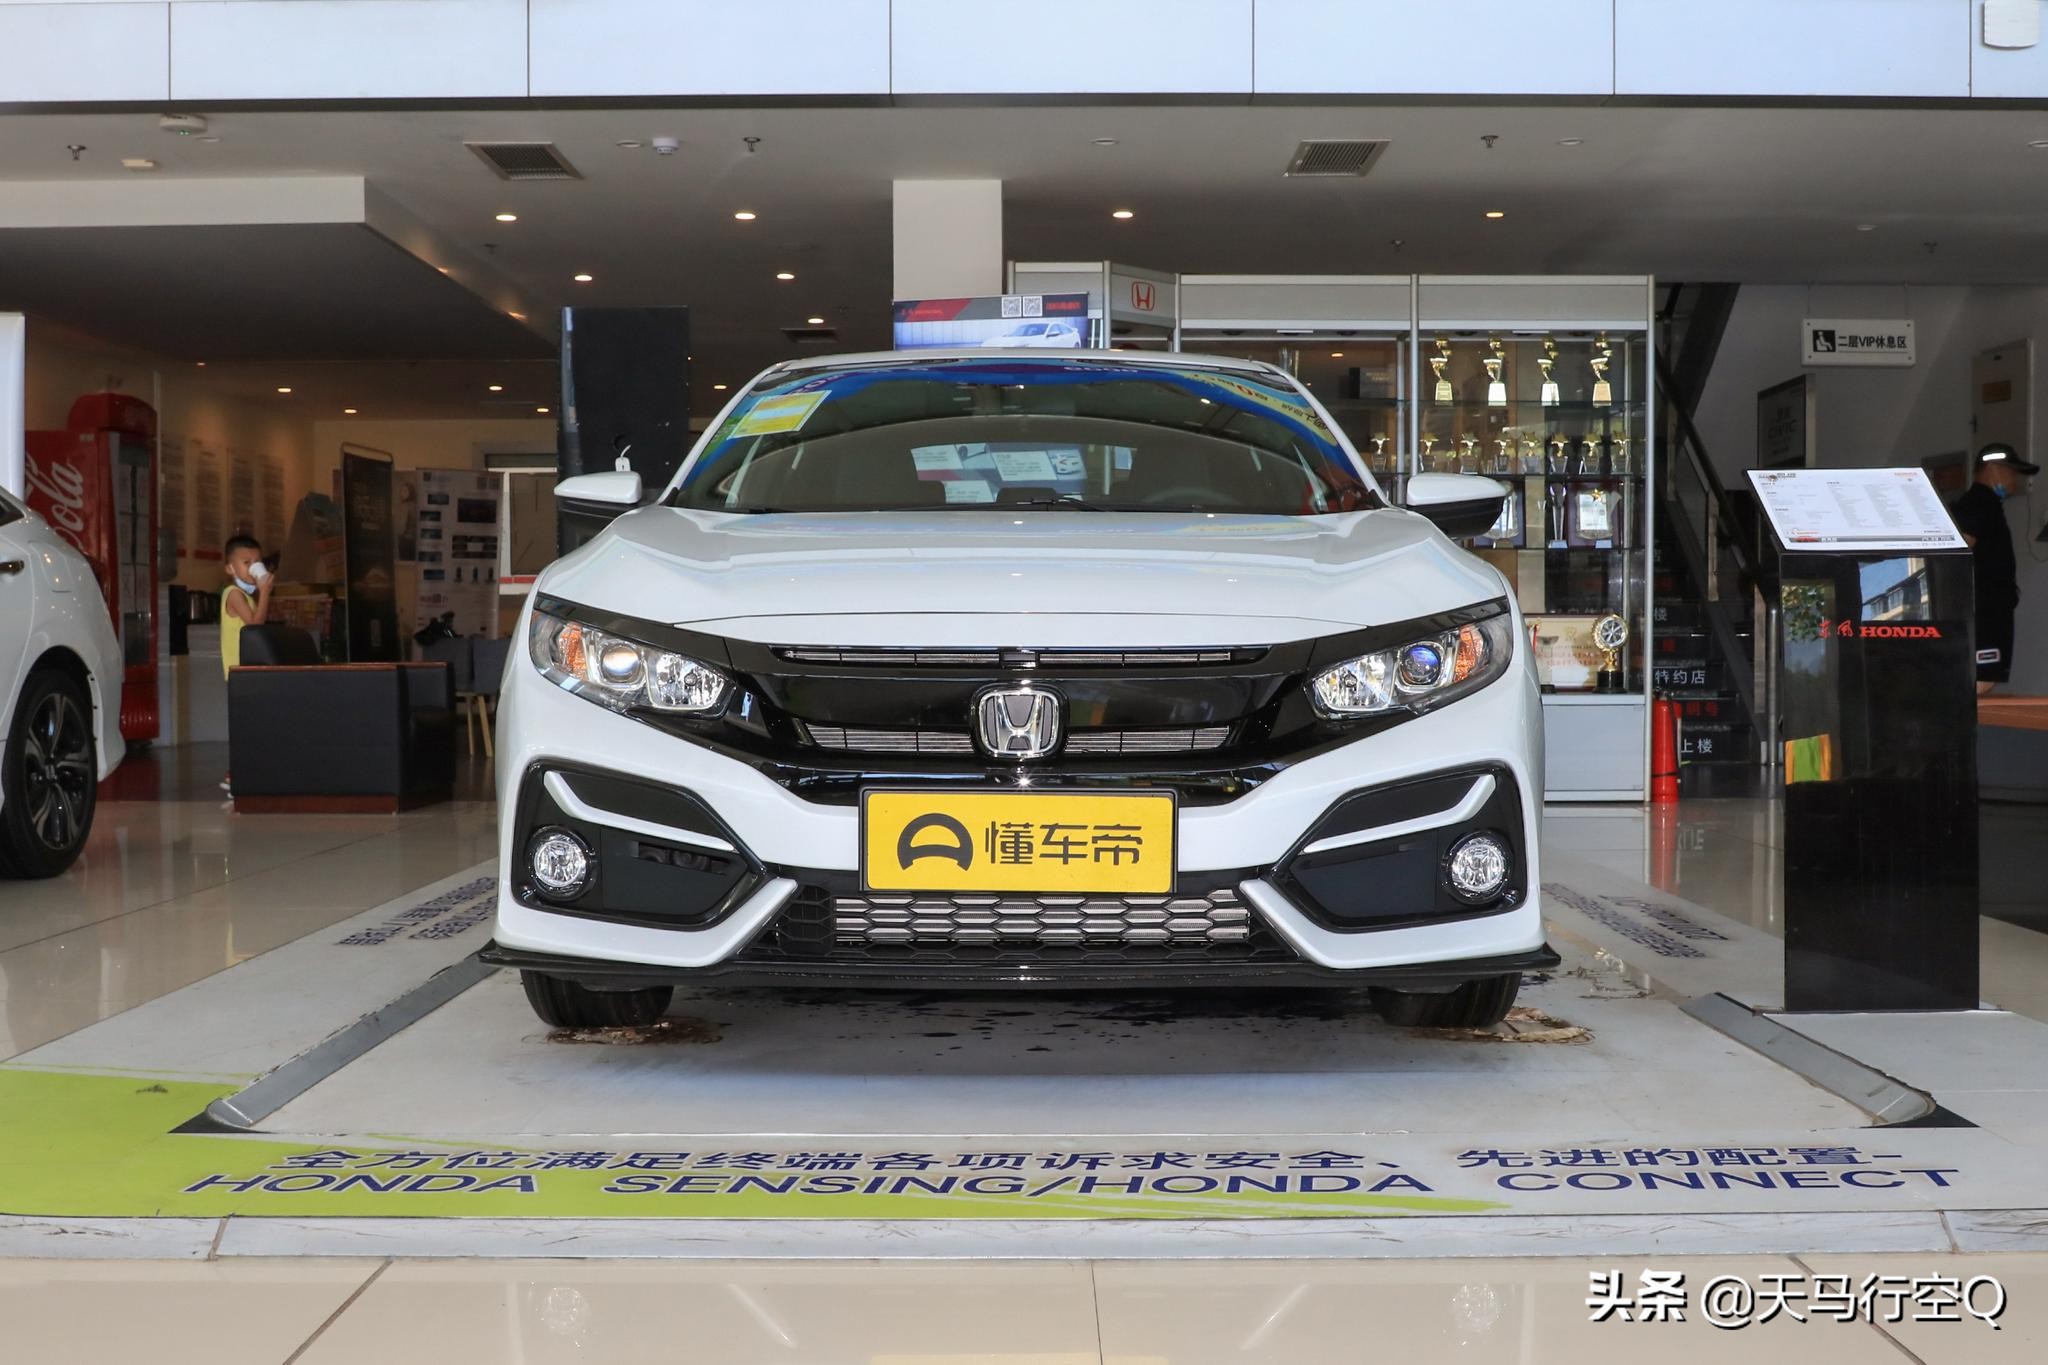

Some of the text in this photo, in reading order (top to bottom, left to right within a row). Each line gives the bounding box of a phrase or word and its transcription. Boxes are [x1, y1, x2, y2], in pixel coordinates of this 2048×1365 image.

[1838, 335, 1907, 349] 二层VIP休息区
[1859, 626, 1943, 638] HONDA
[1681, 738, 1713, 754] 上楼
[985, 821, 1143, 866] 懂车帝
[184, 1174, 536, 1193] HONDA
[1497, 1168, 1958, 1190] CONNECT
